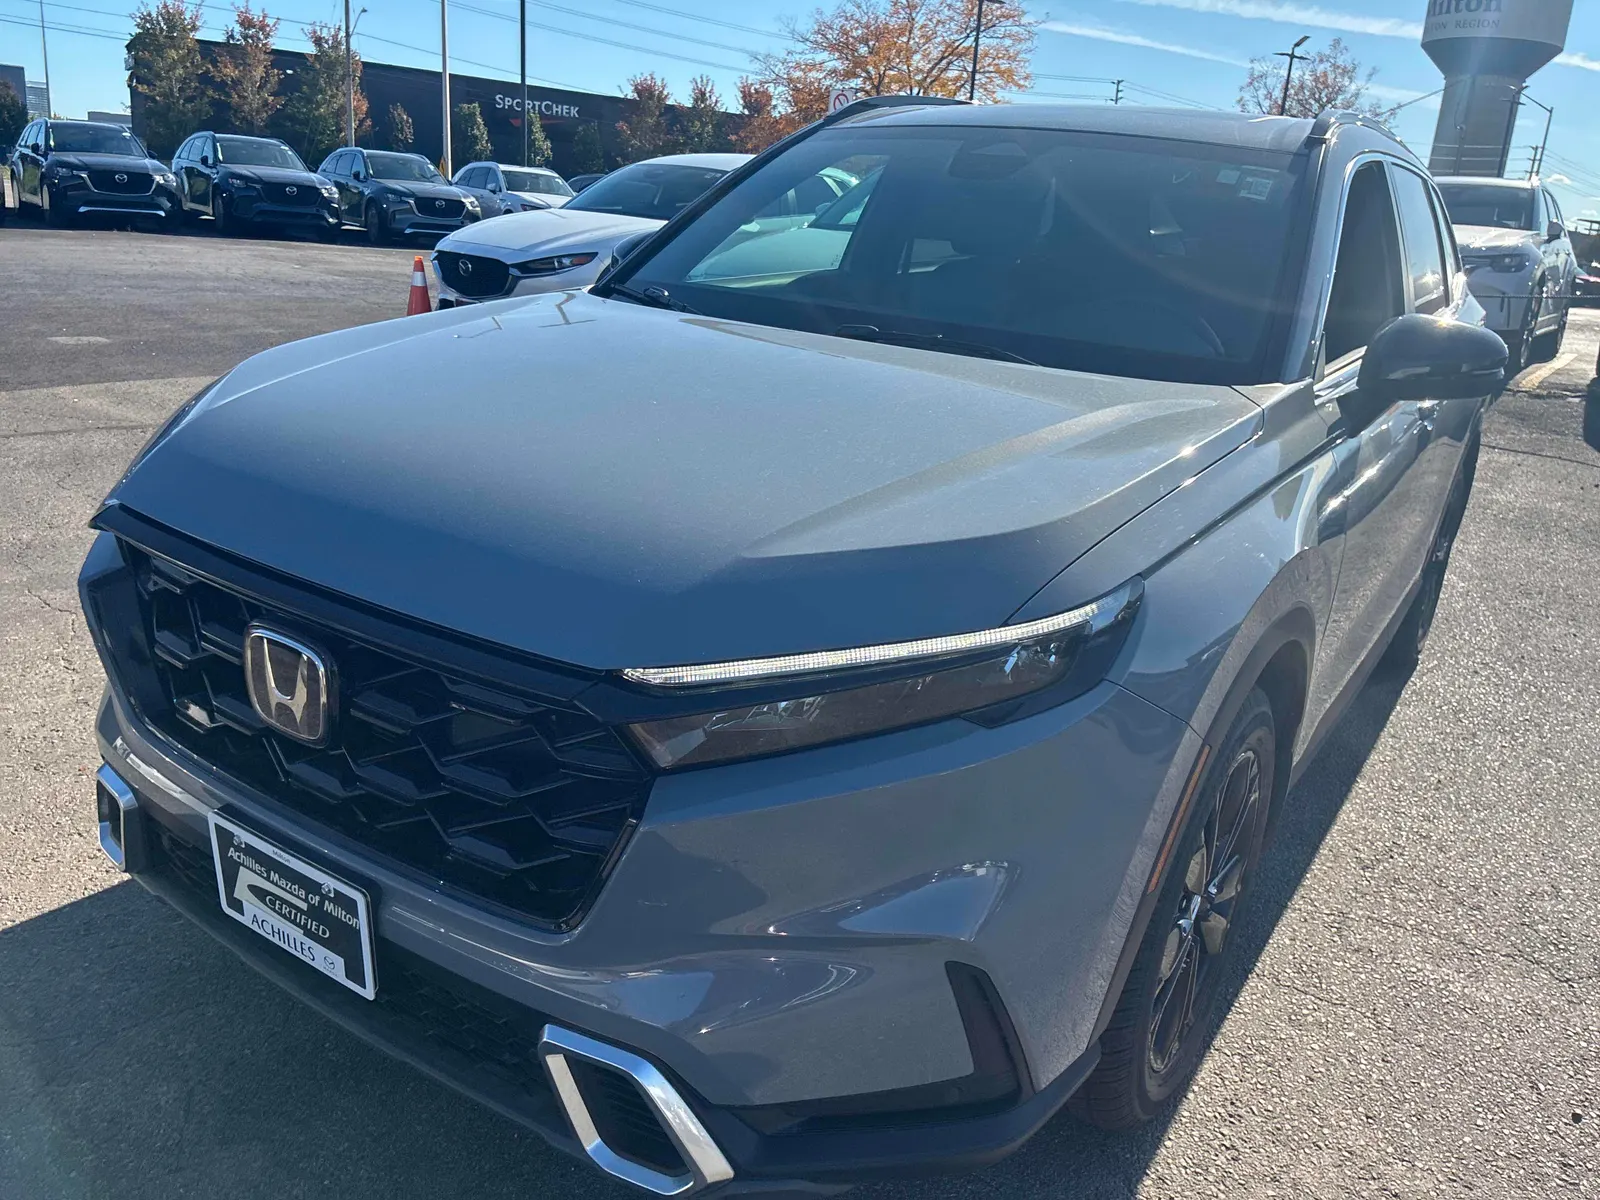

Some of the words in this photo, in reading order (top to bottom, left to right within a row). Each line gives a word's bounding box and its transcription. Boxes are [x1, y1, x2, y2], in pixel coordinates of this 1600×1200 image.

[1455, 19, 1500, 29] REGION
[227, 847, 267, 878] Achilles
[270, 870, 306, 900] Mazda
[308, 893, 321, 906] of
[324, 900, 360, 930] Milton
[251, 913, 316, 962] ACHILLES
[265, 895, 330, 938] CERTIFIED
